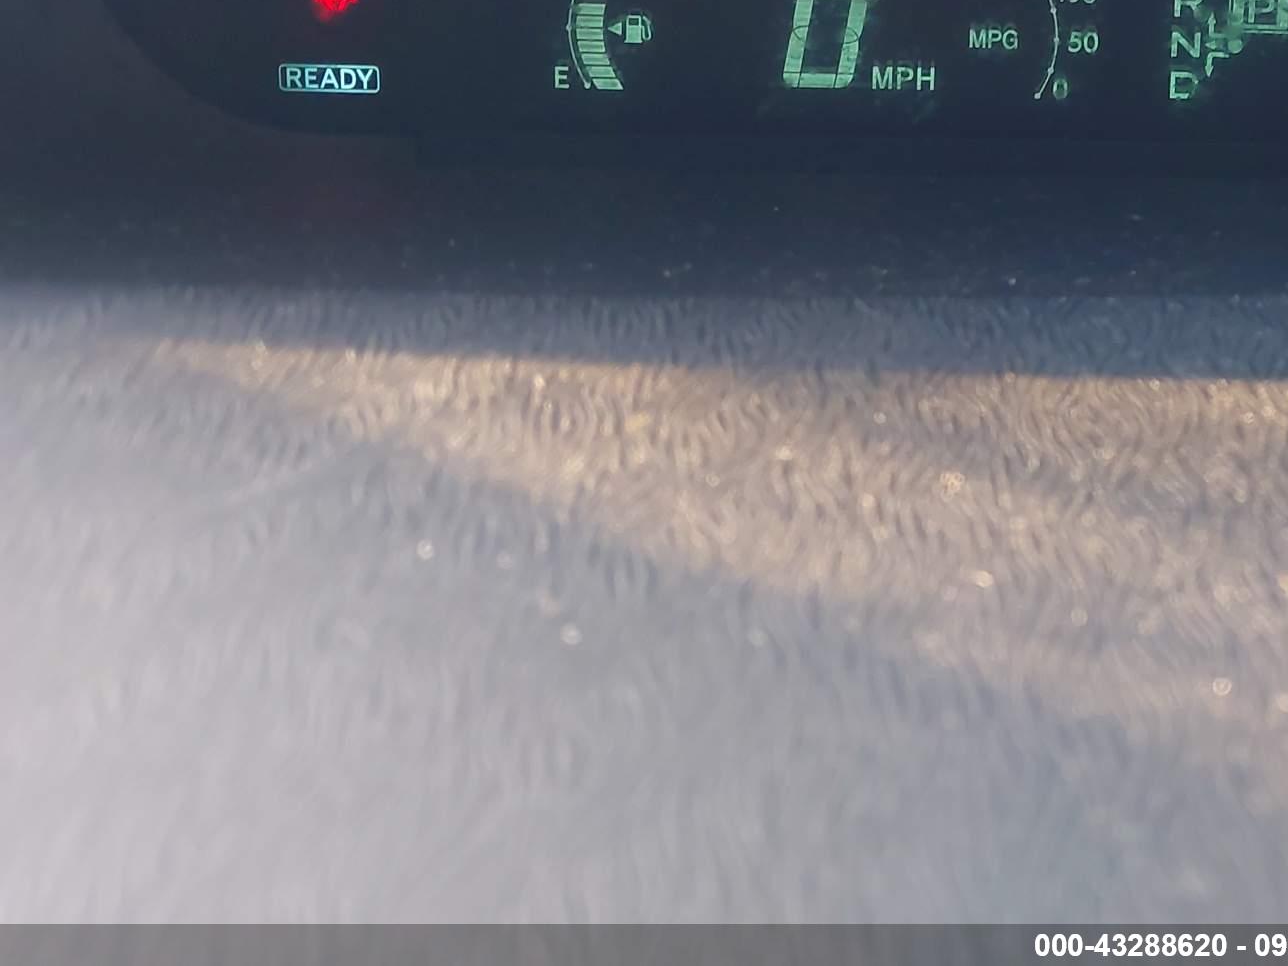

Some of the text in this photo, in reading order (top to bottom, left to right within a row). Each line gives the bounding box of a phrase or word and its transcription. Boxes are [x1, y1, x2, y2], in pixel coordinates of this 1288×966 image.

[968, 29, 1018, 50] MPG
[1067, 32, 1099, 54] 50
[1170, 32, 1201, 58] N
[285, 67, 373, 90] READY
[553, 67, 569, 89] E
[870, 66, 936, 91] MPH
[1052, 79, 1068, 99] 0
[1169, 71, 1199, 99] D
